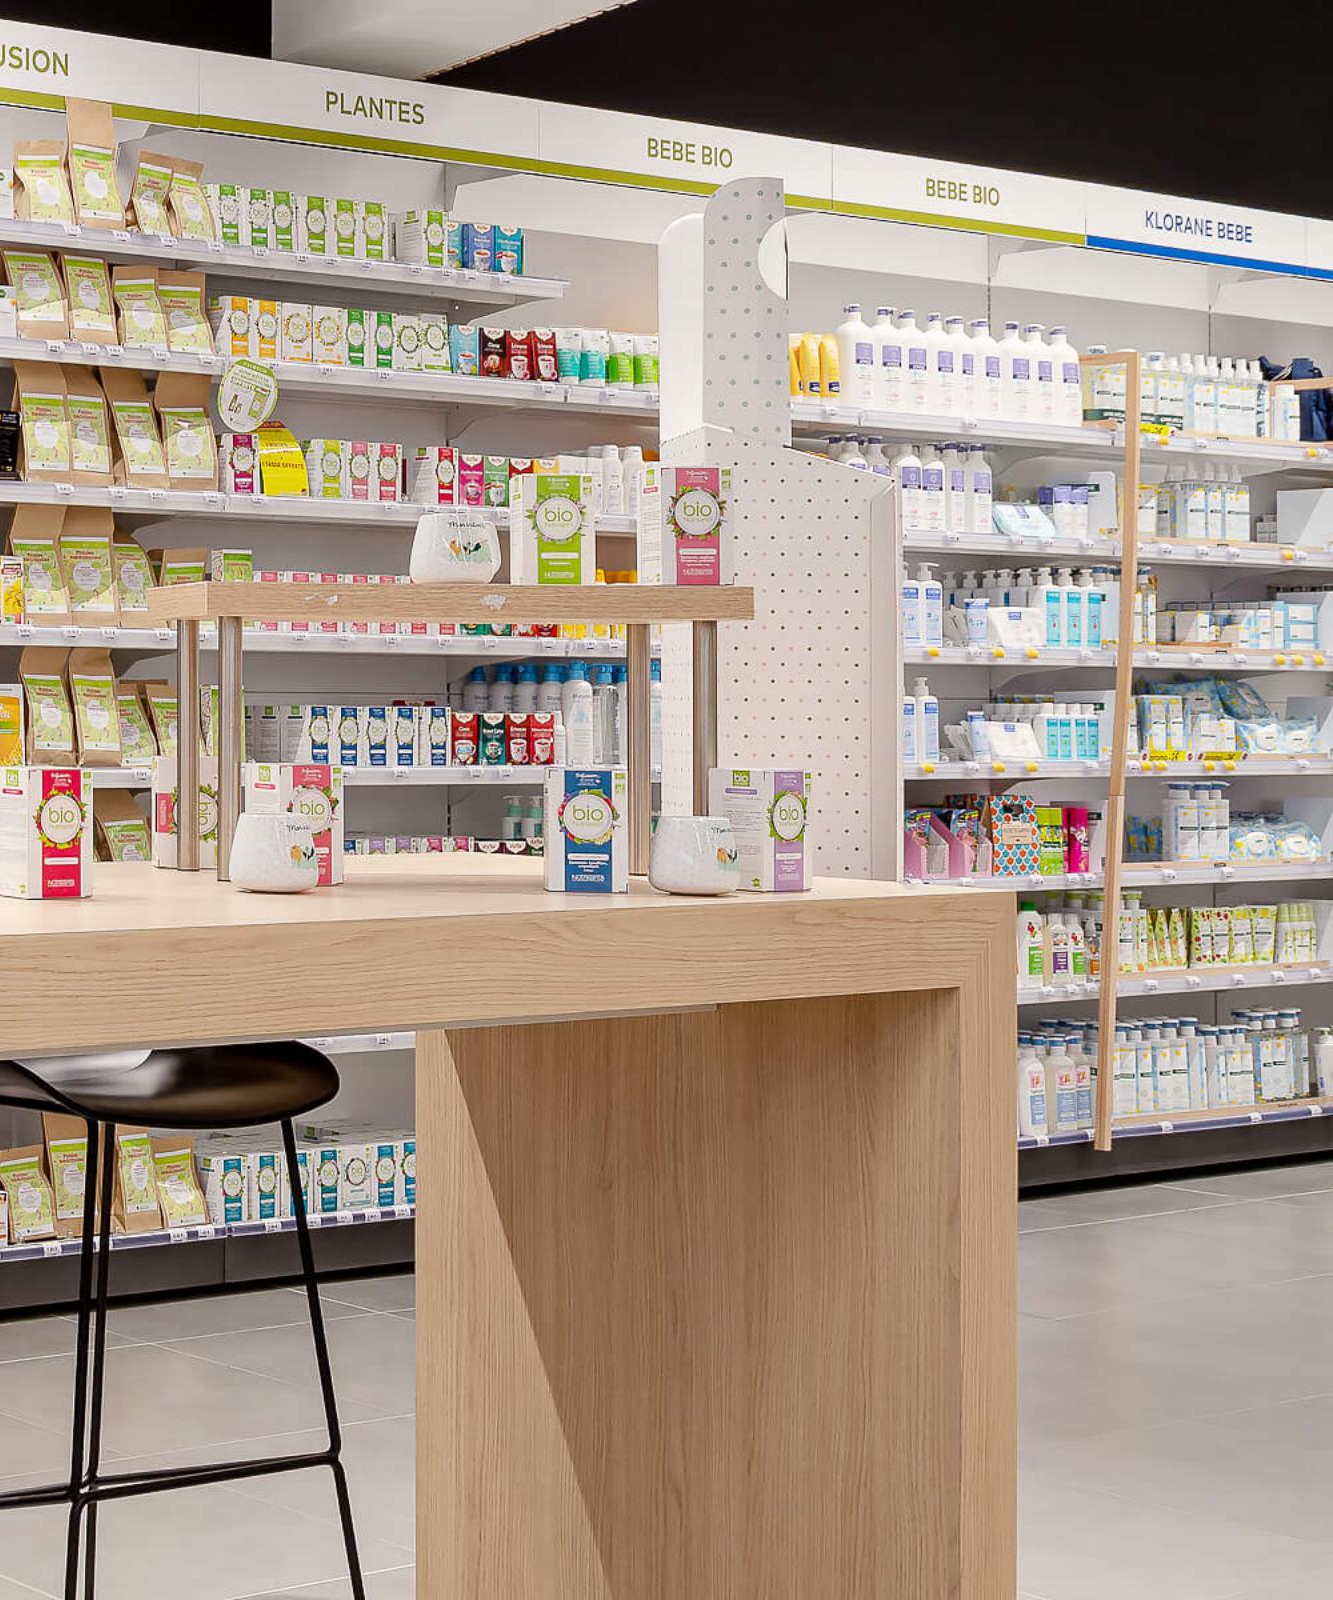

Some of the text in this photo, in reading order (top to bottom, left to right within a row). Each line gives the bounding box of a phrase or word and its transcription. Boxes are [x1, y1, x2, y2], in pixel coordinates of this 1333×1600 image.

[326, 91, 425, 124] PLANTES
[647, 138, 733, 169] BEBE BIO
[925, 179, 1000, 206] BEBE BIO
[1145, 210, 1253, 243] KLORANE BEBE
[544, 506, 574, 523] bio
[683, 501, 713, 518] bio
[48, 805, 74, 824] bio
[299, 799, 325, 817] bio
[572, 805, 603, 823] bio
[779, 805, 798, 823] bio
